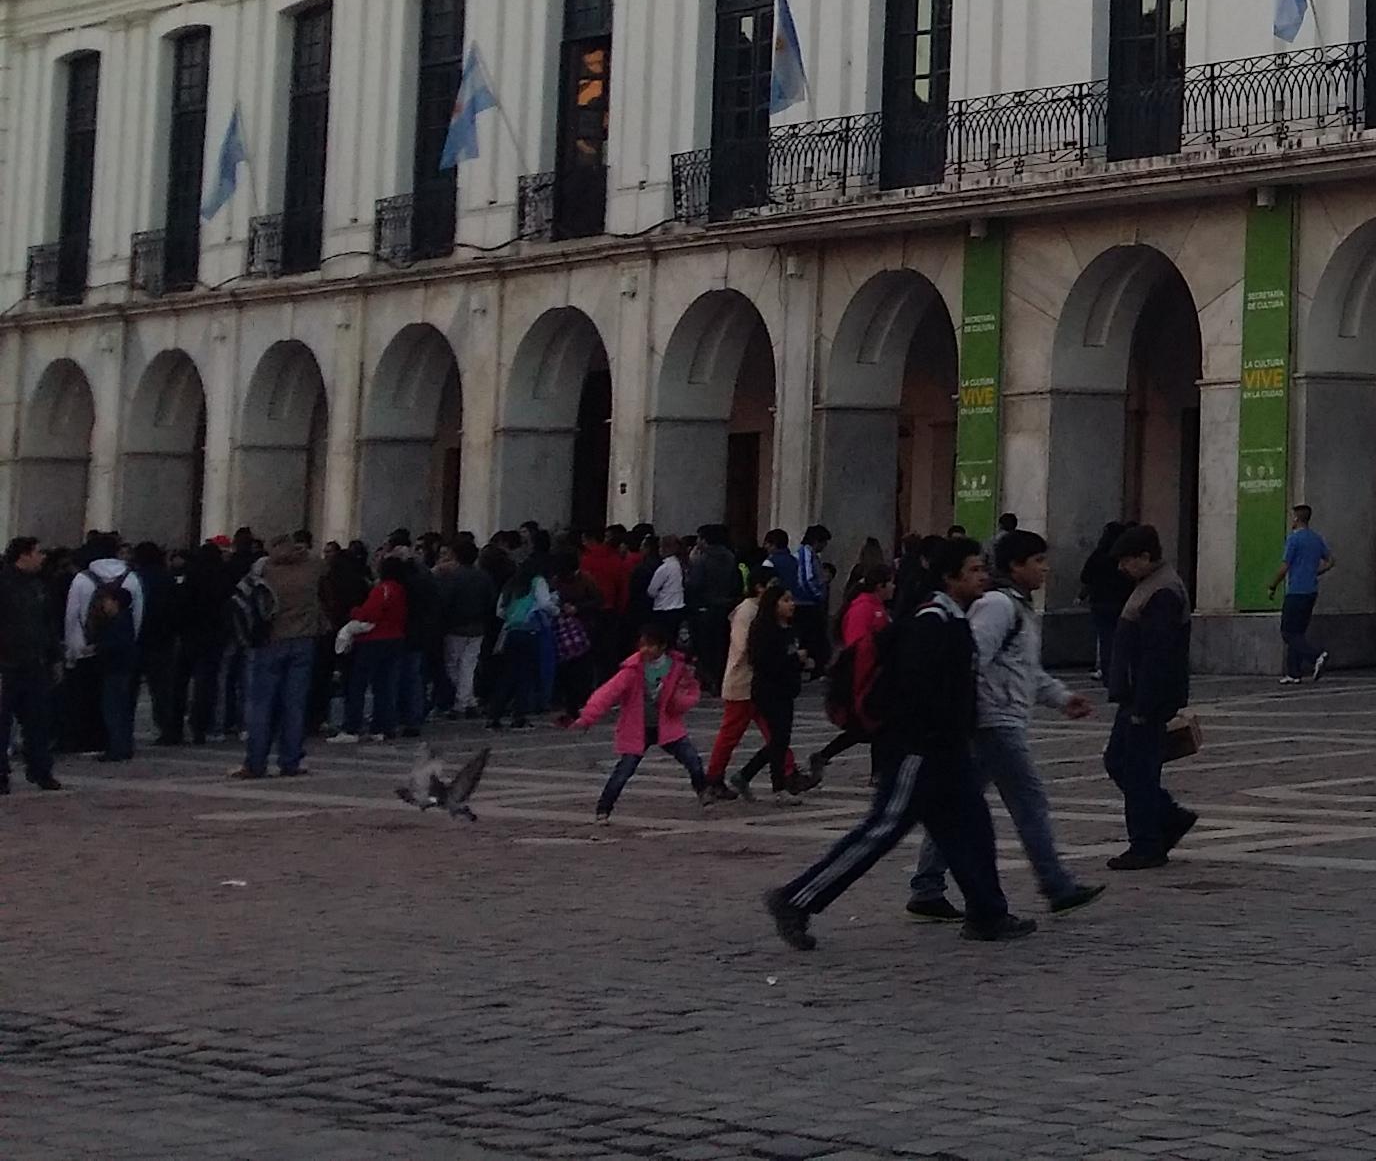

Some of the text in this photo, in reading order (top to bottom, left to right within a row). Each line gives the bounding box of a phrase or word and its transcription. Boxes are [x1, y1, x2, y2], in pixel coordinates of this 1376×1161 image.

[1257, 299, 1284, 310] CULTURA
[1244, 358, 1284, 369] LA CULTURA
[970, 377, 994, 386] CULTURA
[1244, 369, 1283, 389] VIVE
[960, 386, 993, 406] VIVE
[1252, 390, 1260, 398] LA
